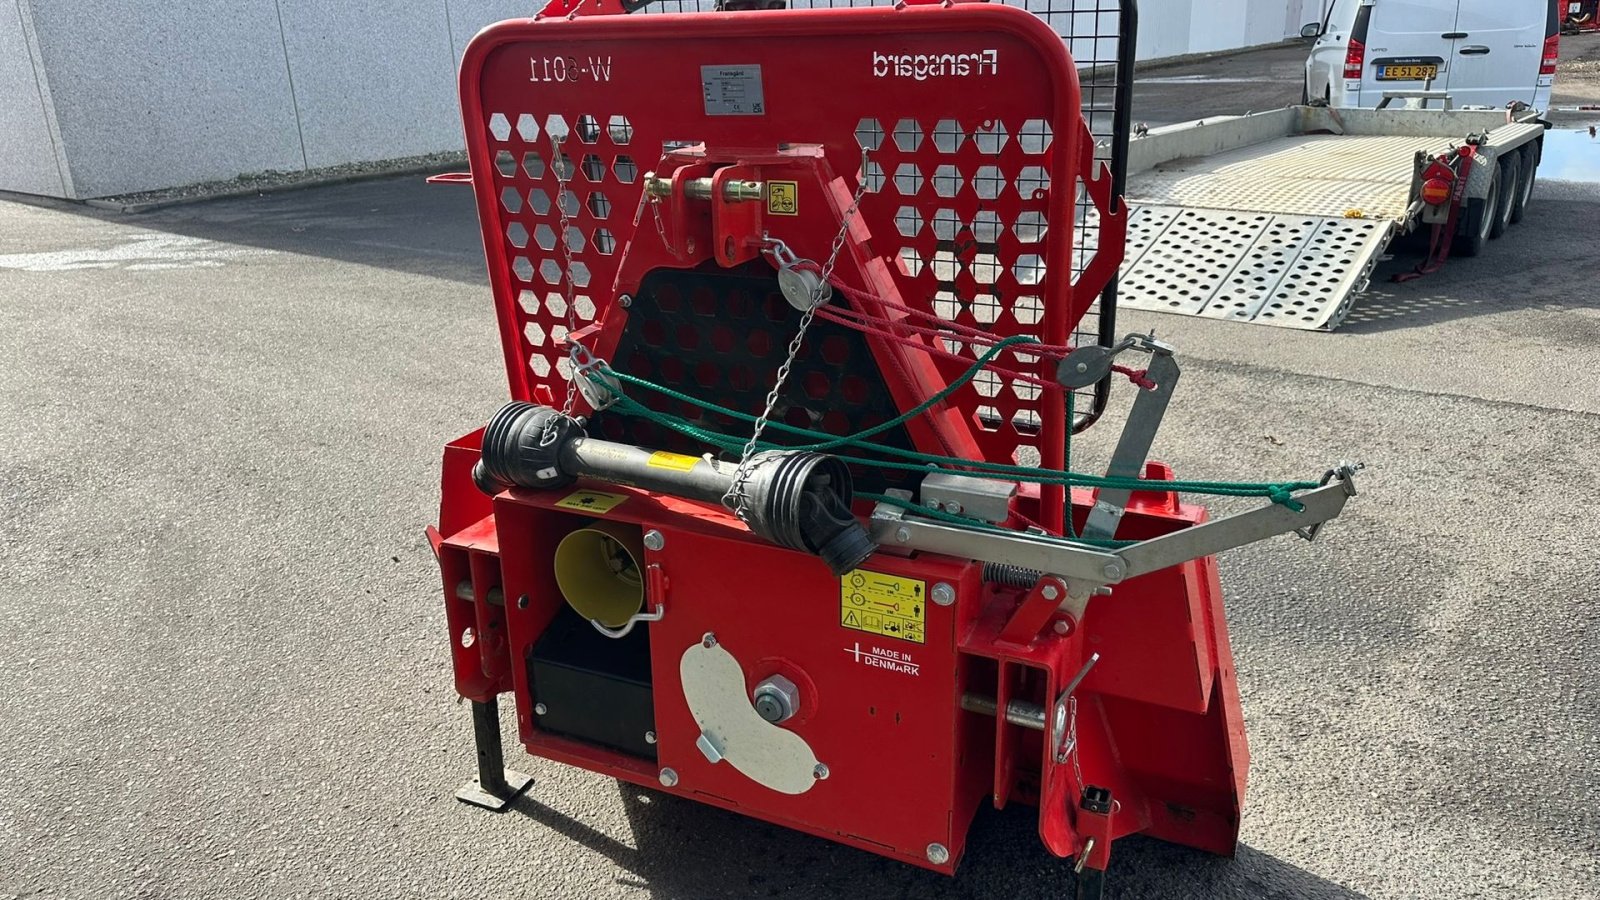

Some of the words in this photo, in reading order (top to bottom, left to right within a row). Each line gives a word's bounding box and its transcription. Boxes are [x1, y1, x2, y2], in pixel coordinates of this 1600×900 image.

[1385, 67, 1398, 76] EE
[1401, 67, 1411, 76] 51
[1416, 66, 1434, 76] 287
[872, 646, 899, 659] MADE
[902, 653, 912, 662] IN
[864, 656, 919, 676] DENMARK
